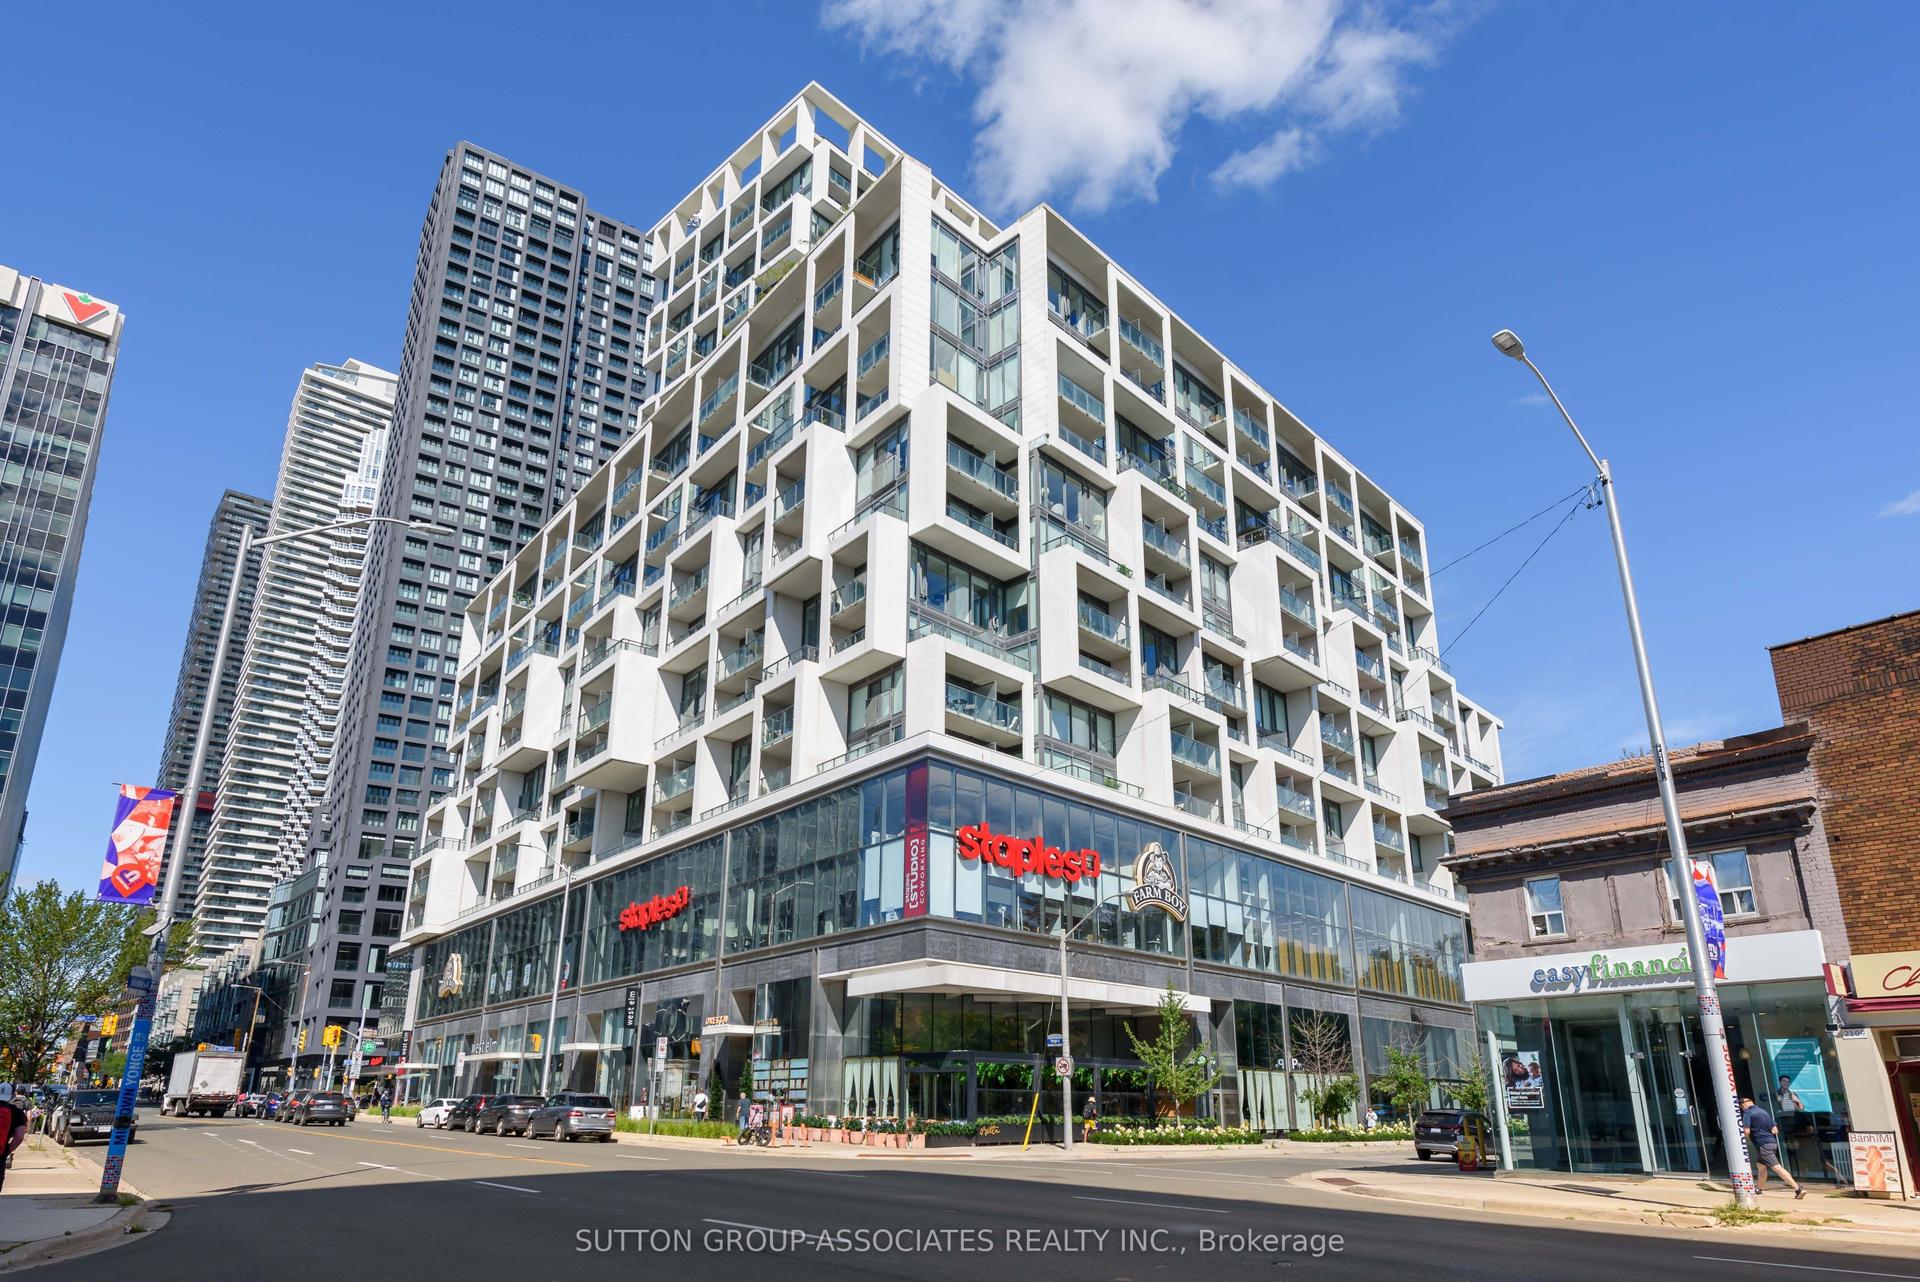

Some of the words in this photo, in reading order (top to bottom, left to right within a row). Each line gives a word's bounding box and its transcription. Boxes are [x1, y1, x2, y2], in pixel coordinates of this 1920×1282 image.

[957, 821, 1081, 883] staples
[618, 895, 677, 931] staples
[1133, 885, 1163, 904] FARM
[1164, 890, 1186, 913] BOY
[1533, 947, 1692, 988] easyfinanci
[628, 990, 637, 1005] elm
[627, 1007, 635, 1026] west
[113, 1087, 136, 1147] MIOWN
[125, 1045, 145, 1085] YONGE
